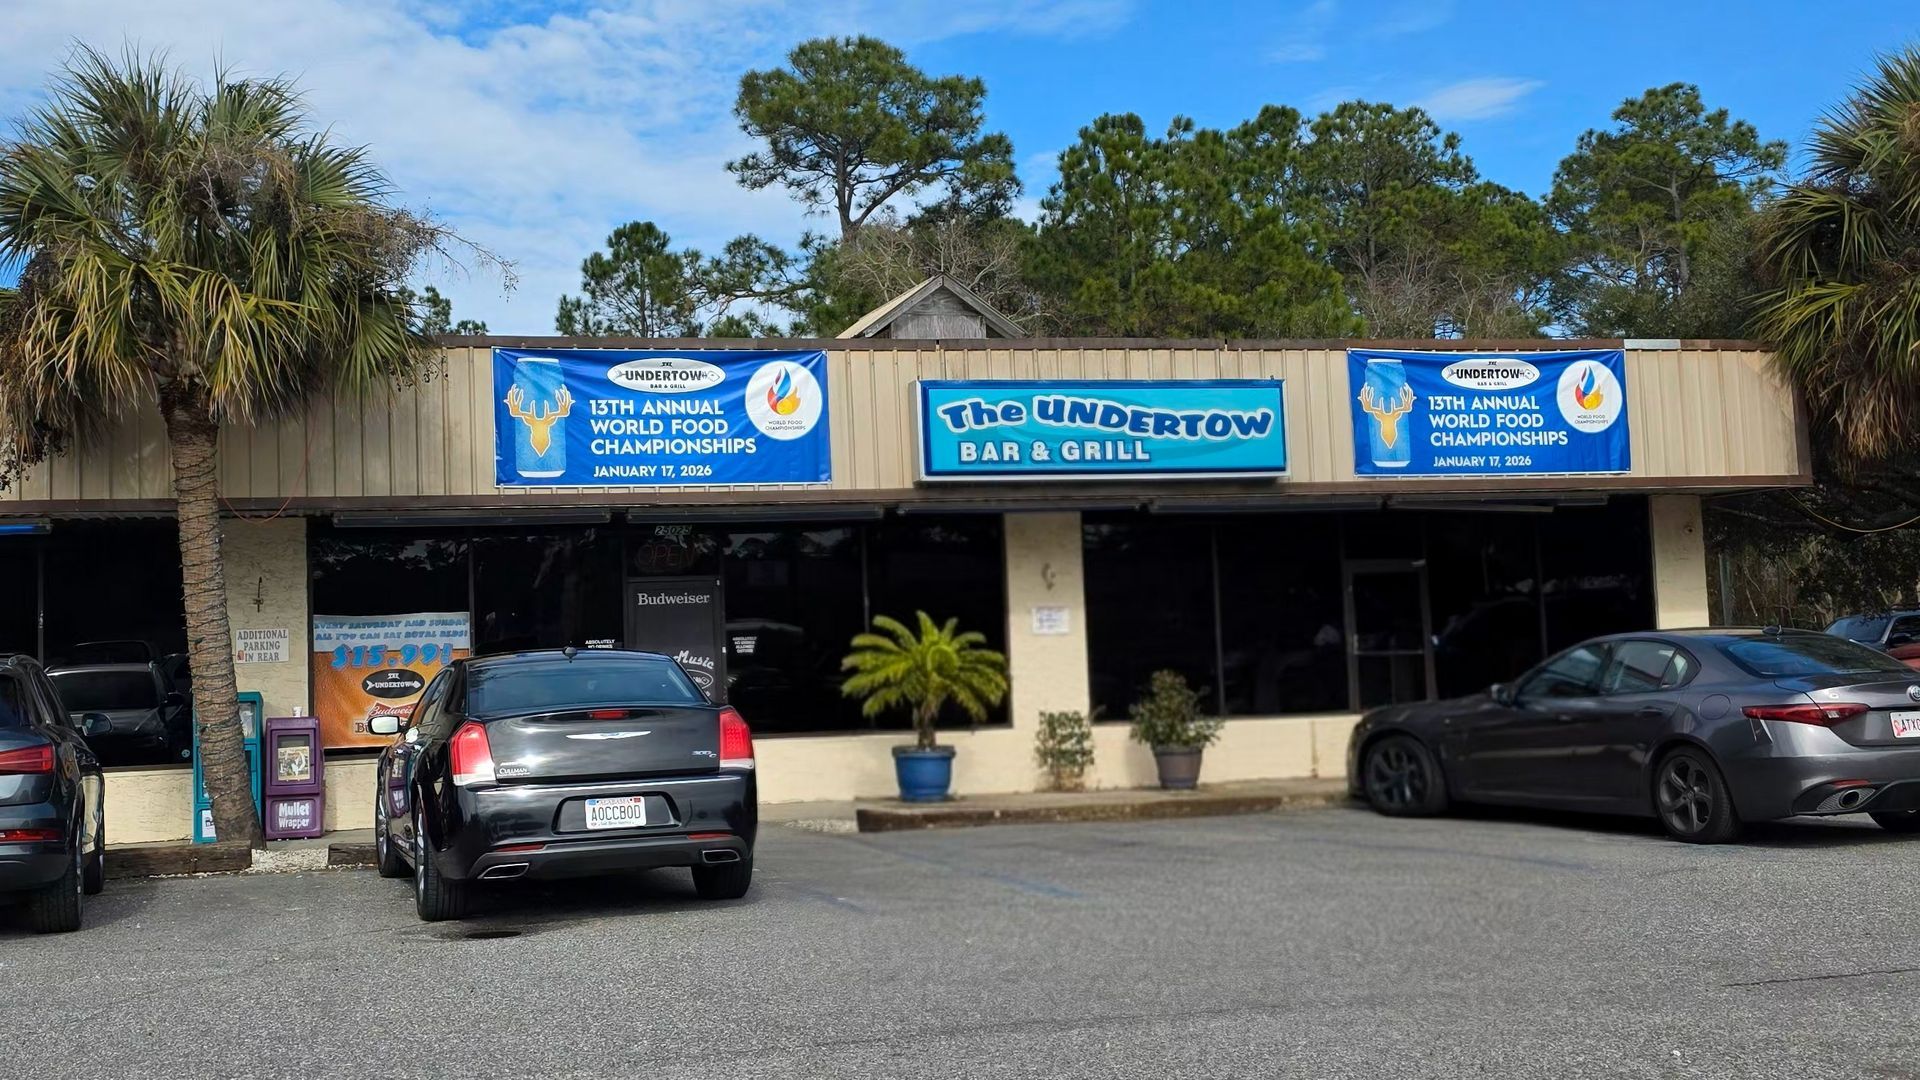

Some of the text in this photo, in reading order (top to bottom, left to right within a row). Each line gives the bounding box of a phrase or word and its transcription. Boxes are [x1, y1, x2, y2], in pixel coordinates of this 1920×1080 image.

[625, 370, 702, 381] UNDERTOW
[1456, 368, 1520, 379] UNDERTOW
[590, 399, 724, 416] 13TH ANNUAL
[1428, 396, 1540, 411] 13TH ANNUAL
[940, 397, 1273, 438] The UNDERTOW
[1429, 414, 1544, 429] WORLD FOOD
[590, 419, 729, 436] WORLD FOOD
[1430, 431, 1568, 447] CHAMPIONSHIPS
[590, 438, 757, 455] CHAMPIONSHIPS
[960, 440, 1150, 462] BAR & GRILL
[1433, 455, 1532, 469] JANUARY 17, 2026
[593, 465, 713, 479] JANUARY 17, 2026
[637, 592, 710, 605] Budweiser
[429, 618, 468, 627] SUNDAY
[237, 629, 288, 640] ADDITIONAL
[315, 632, 333, 641] ALL
[360, 631, 381, 640] CAN
[383, 631, 402, 639] EAT
[243, 641, 281, 650] PARKING
[244, 652, 280, 662] IN REAR
[330, 643, 454, 670] $15.99!
[673, 650, 714, 670] Music
[374, 681, 411, 689] UNDERTOW
[279, 801, 310, 817] Mullet
[279, 818, 310, 830] Wrapper
